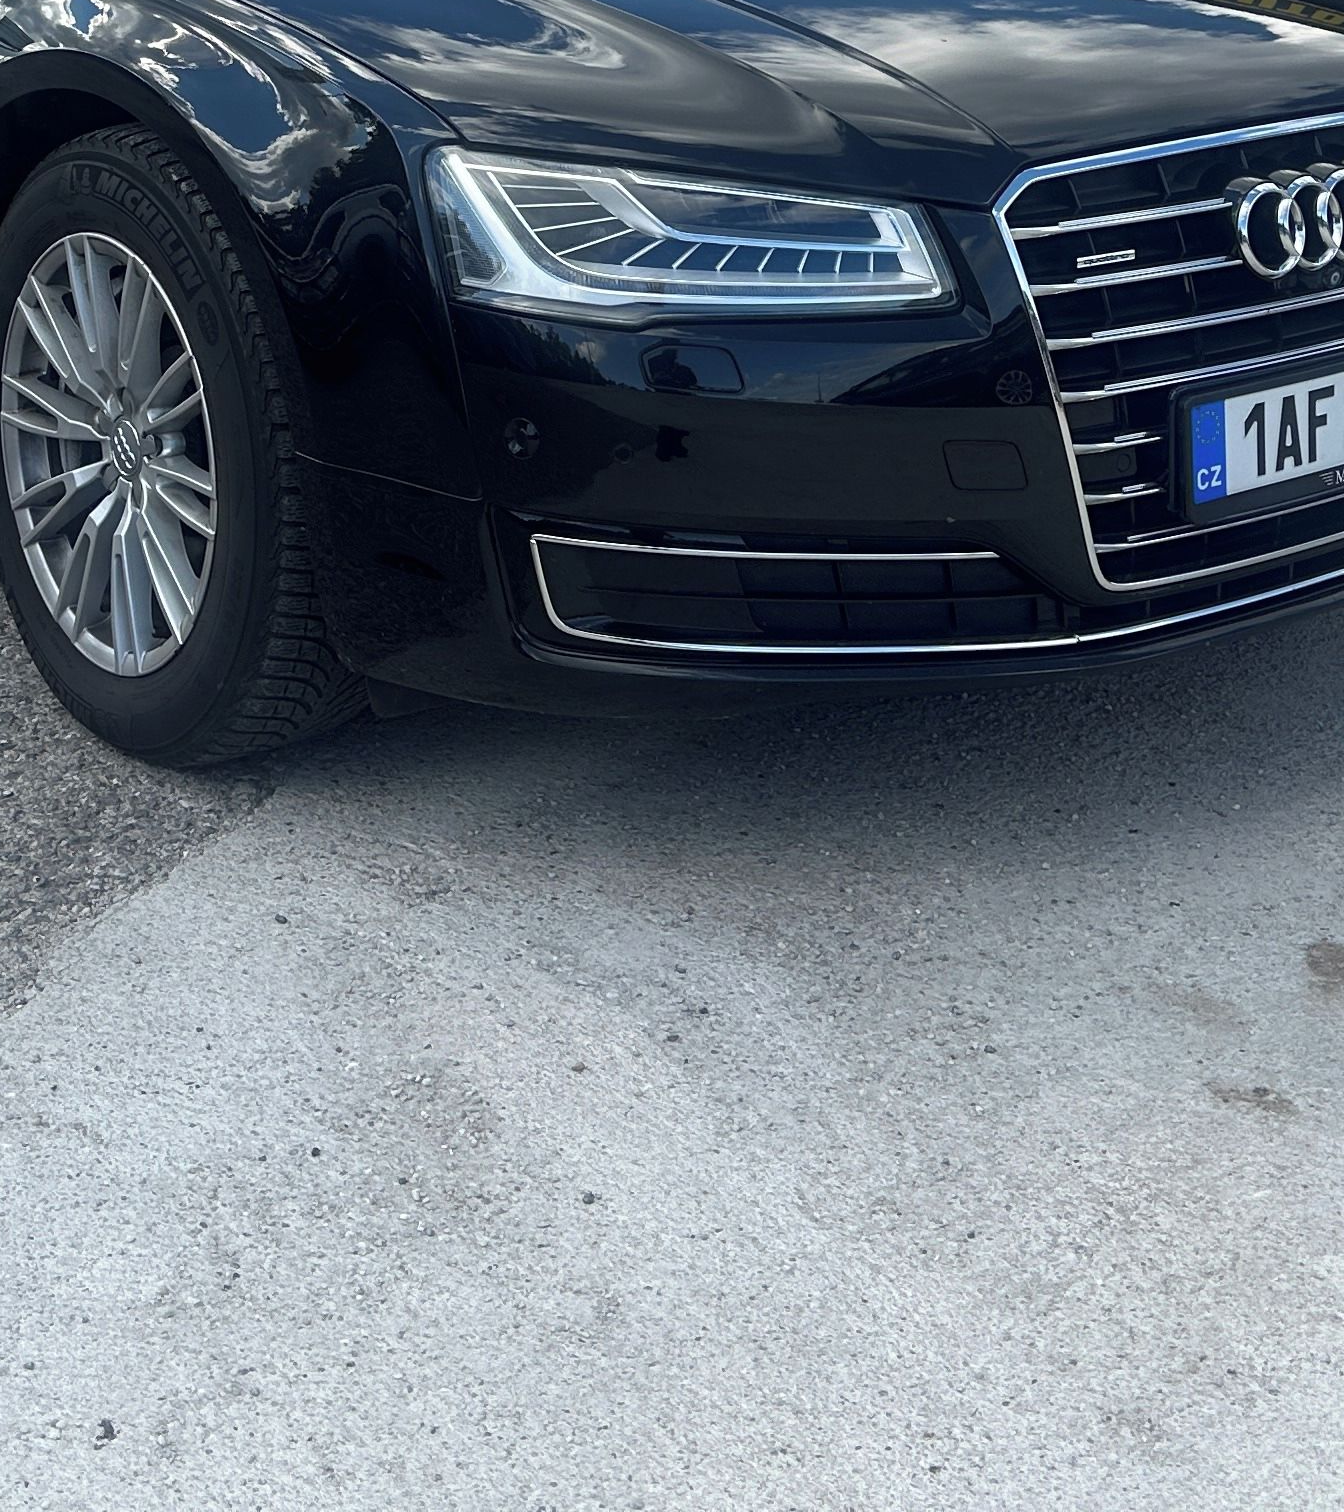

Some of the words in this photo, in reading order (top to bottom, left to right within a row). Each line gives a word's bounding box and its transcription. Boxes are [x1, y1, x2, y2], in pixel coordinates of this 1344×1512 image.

[96, 171, 204, 289] MICHELIN
[1197, 465, 1222, 491] CZ
[1244, 384, 1336, 477] 1AF
